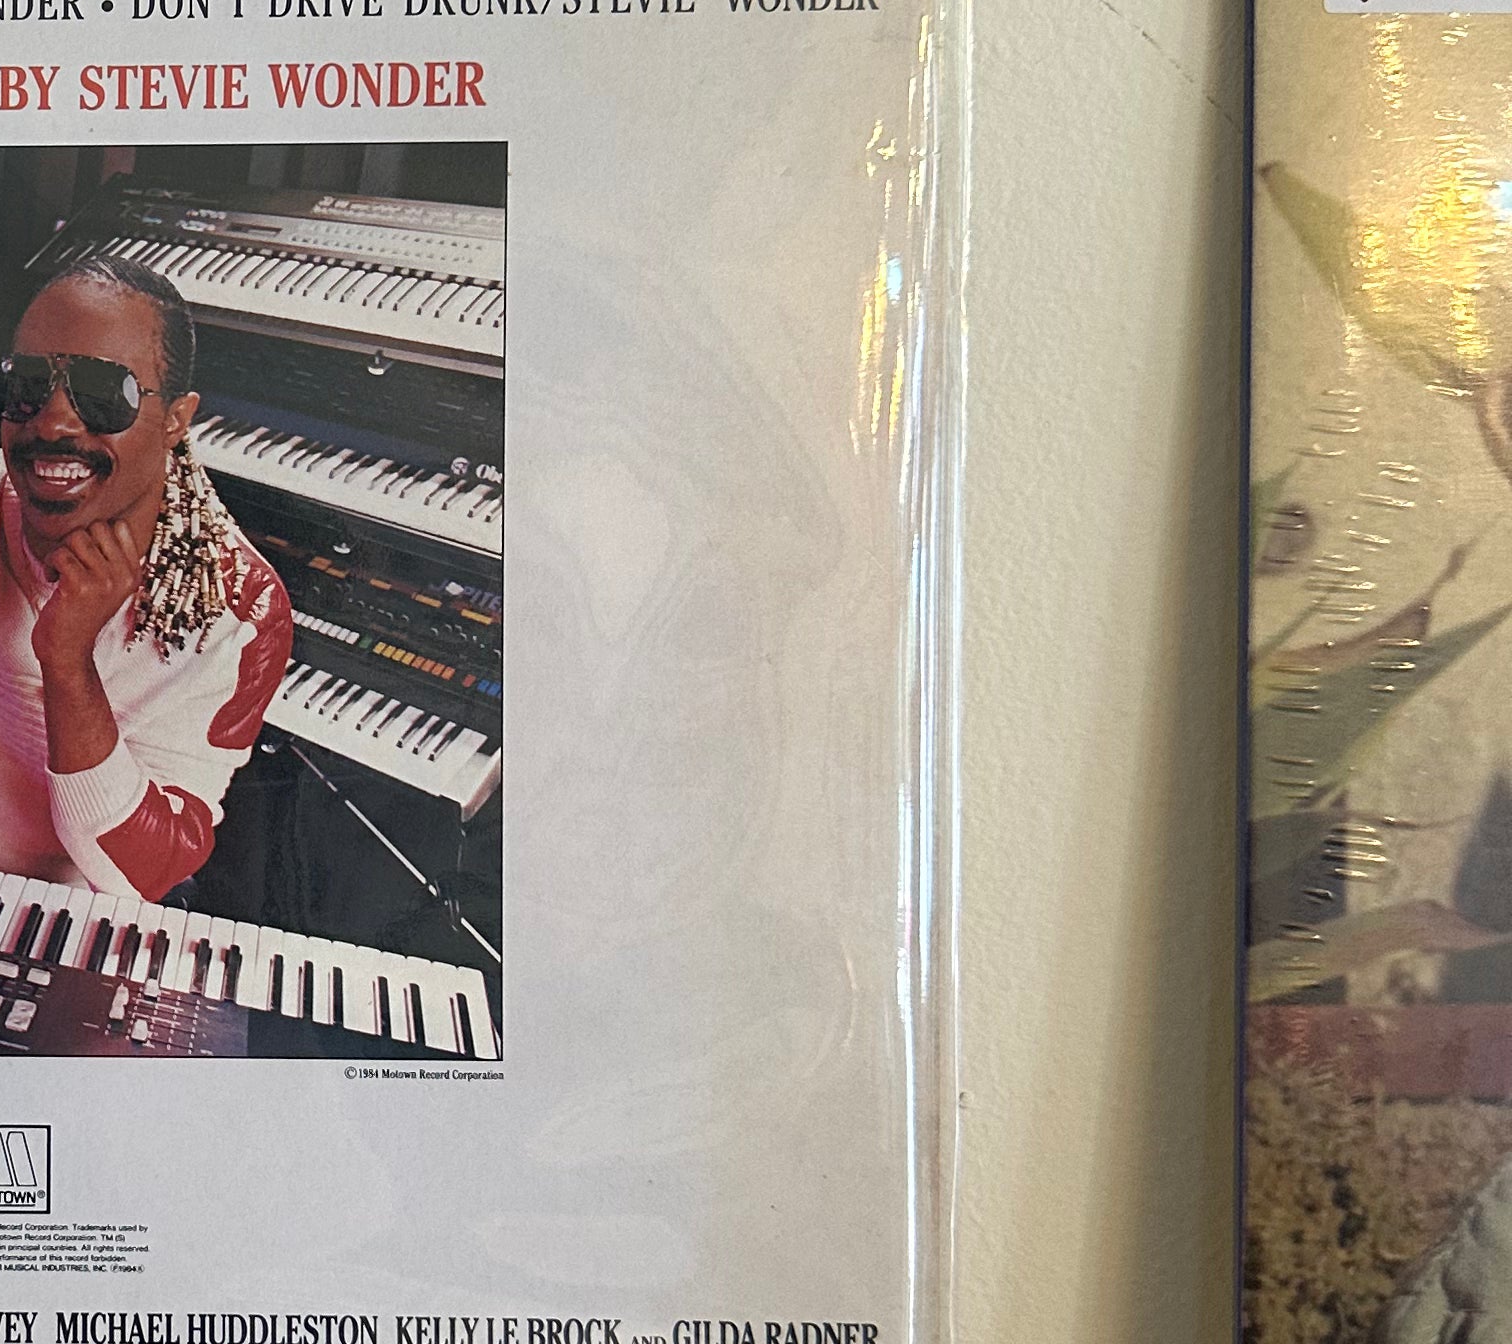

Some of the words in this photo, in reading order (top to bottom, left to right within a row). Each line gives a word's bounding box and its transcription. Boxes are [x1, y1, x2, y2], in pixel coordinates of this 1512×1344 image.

[80, 64, 248, 110] STEVIE
[268, 62, 486, 108] WONDER
[382, 1069, 417, 1078] Motown
[420, 1069, 450, 1079] Record
[452, 1070, 504, 1082] Corporation
[56, 1312, 180, 1344] MICHAEL
